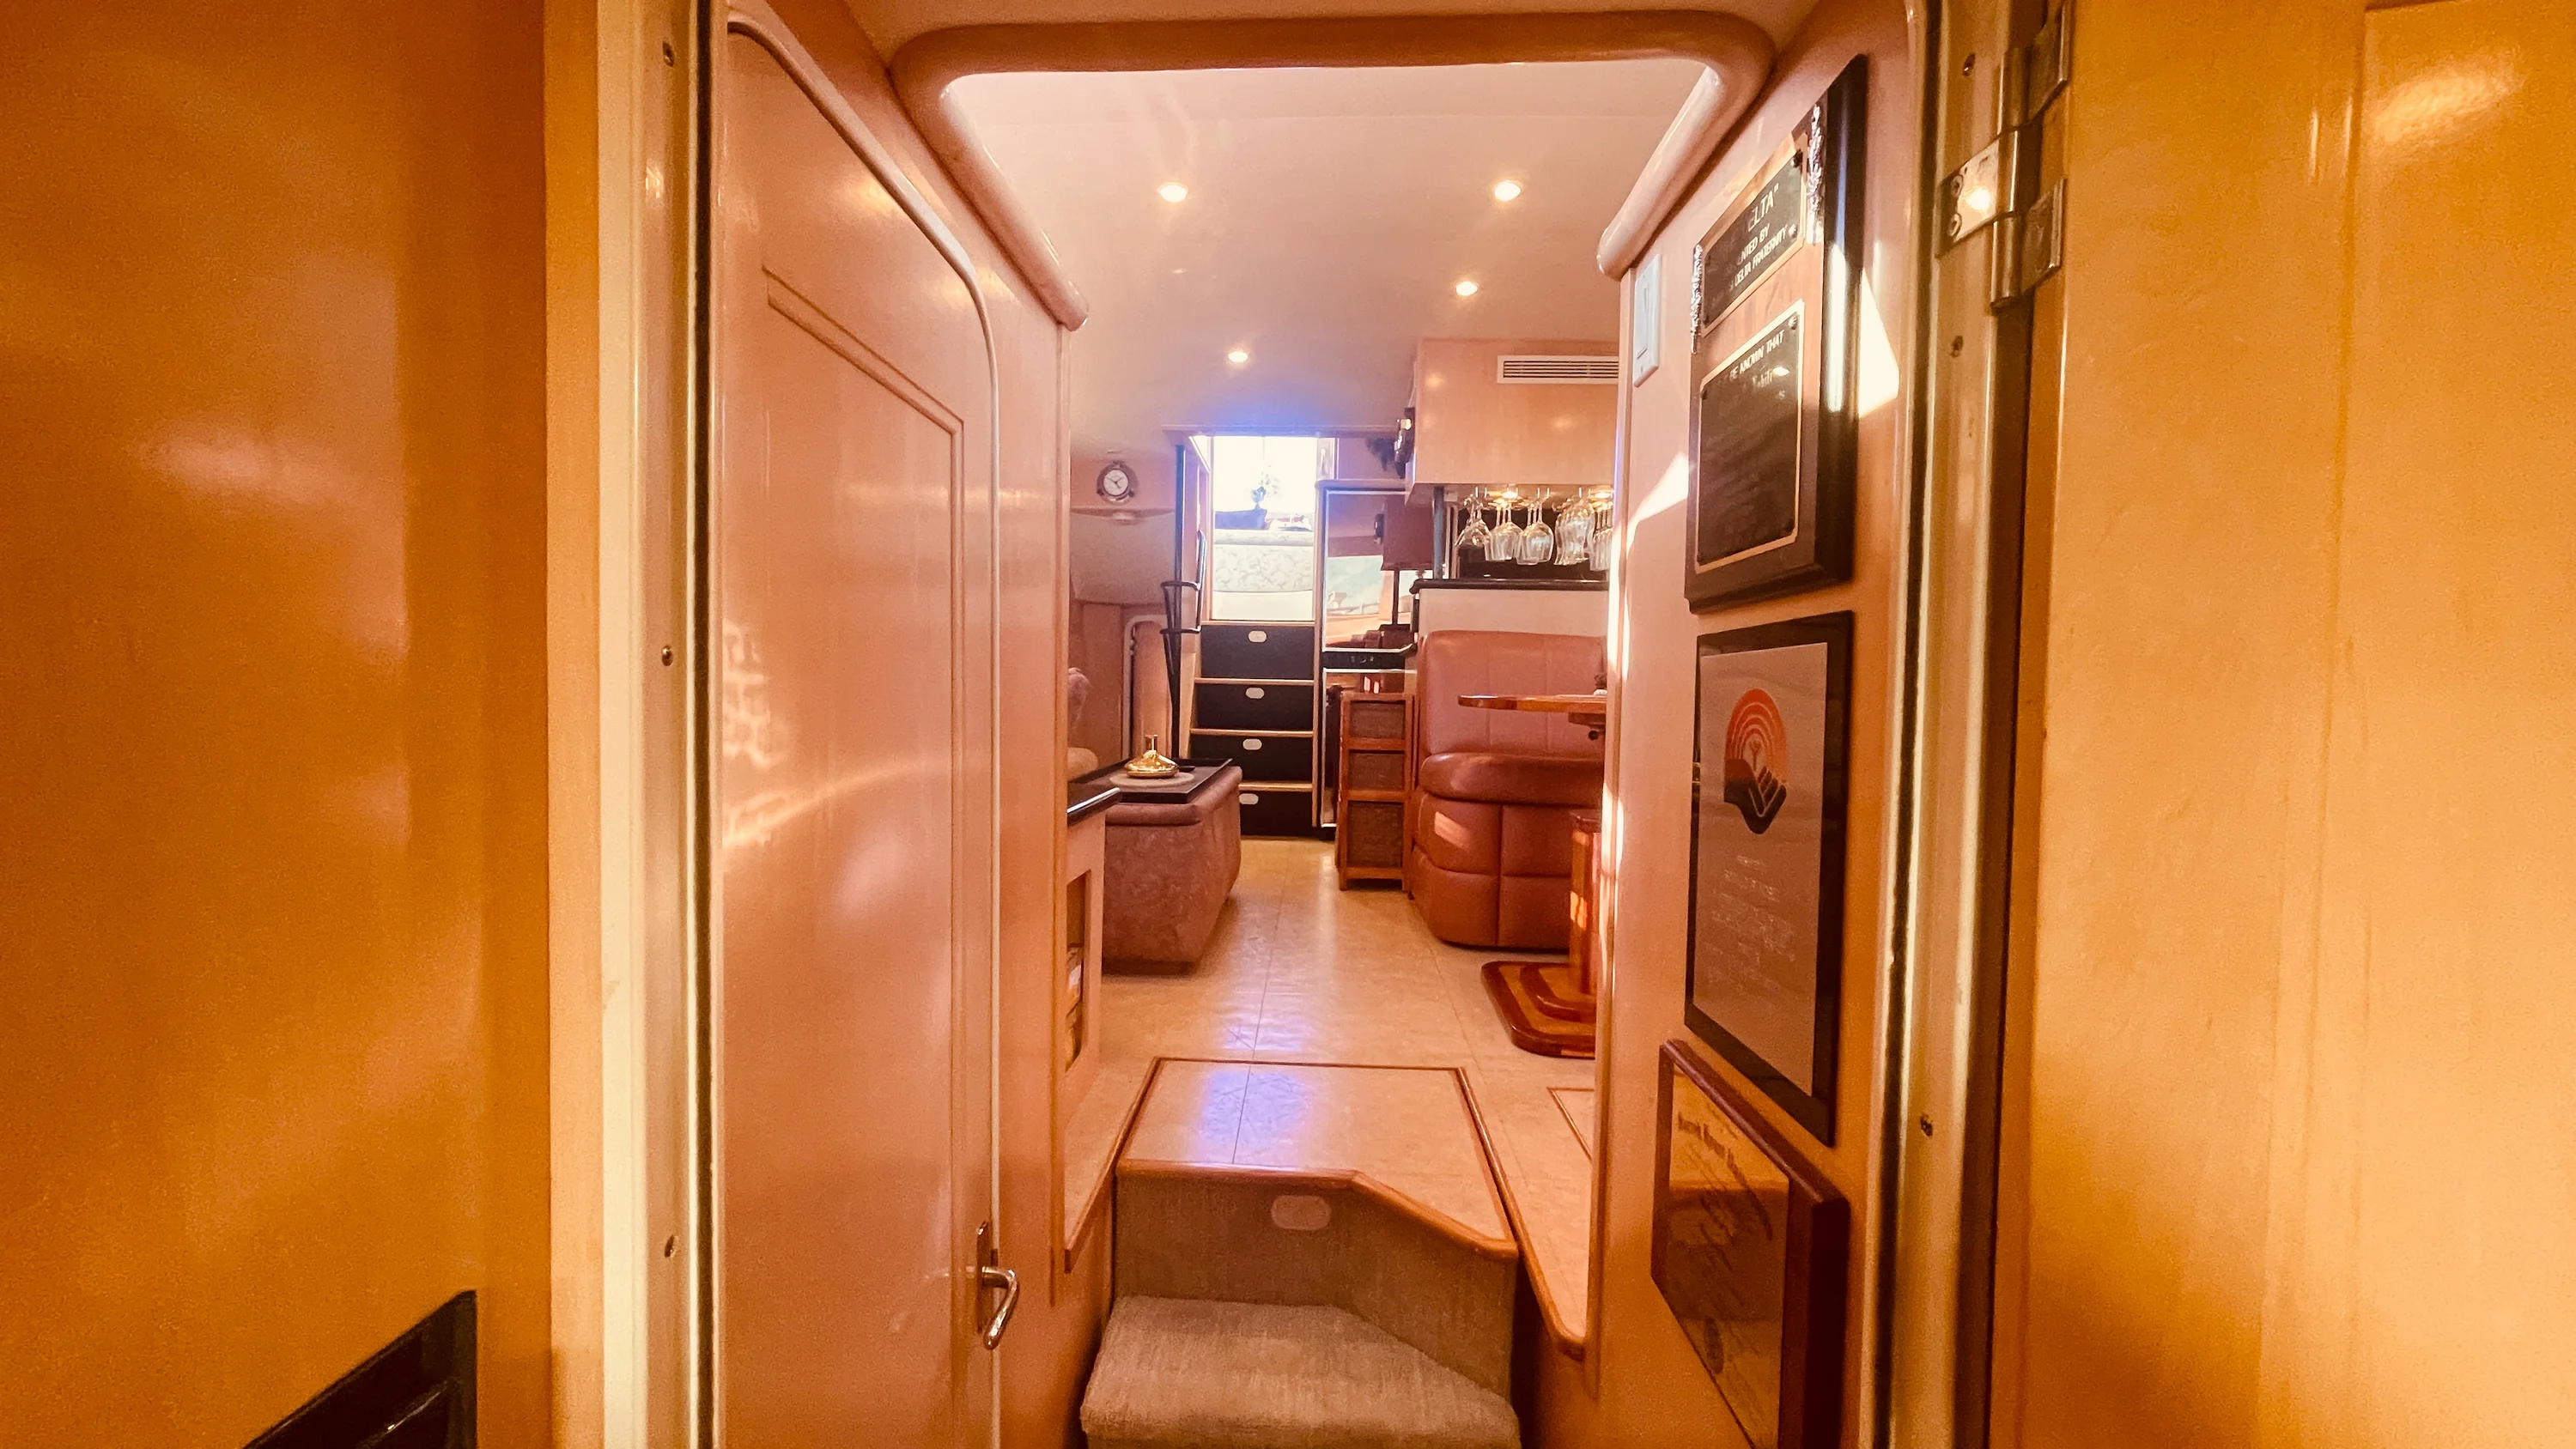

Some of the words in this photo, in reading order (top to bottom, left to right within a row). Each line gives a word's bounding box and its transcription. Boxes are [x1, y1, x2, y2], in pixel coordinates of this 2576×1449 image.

[1735, 261, 1752, 287] DELTA
[1752, 224, 1788, 270] FRATERNITY
[1759, 223, 1771, 244] BY
[1739, 345, 1765, 375] KNOWN
[1765, 329, 1784, 354] THAT
